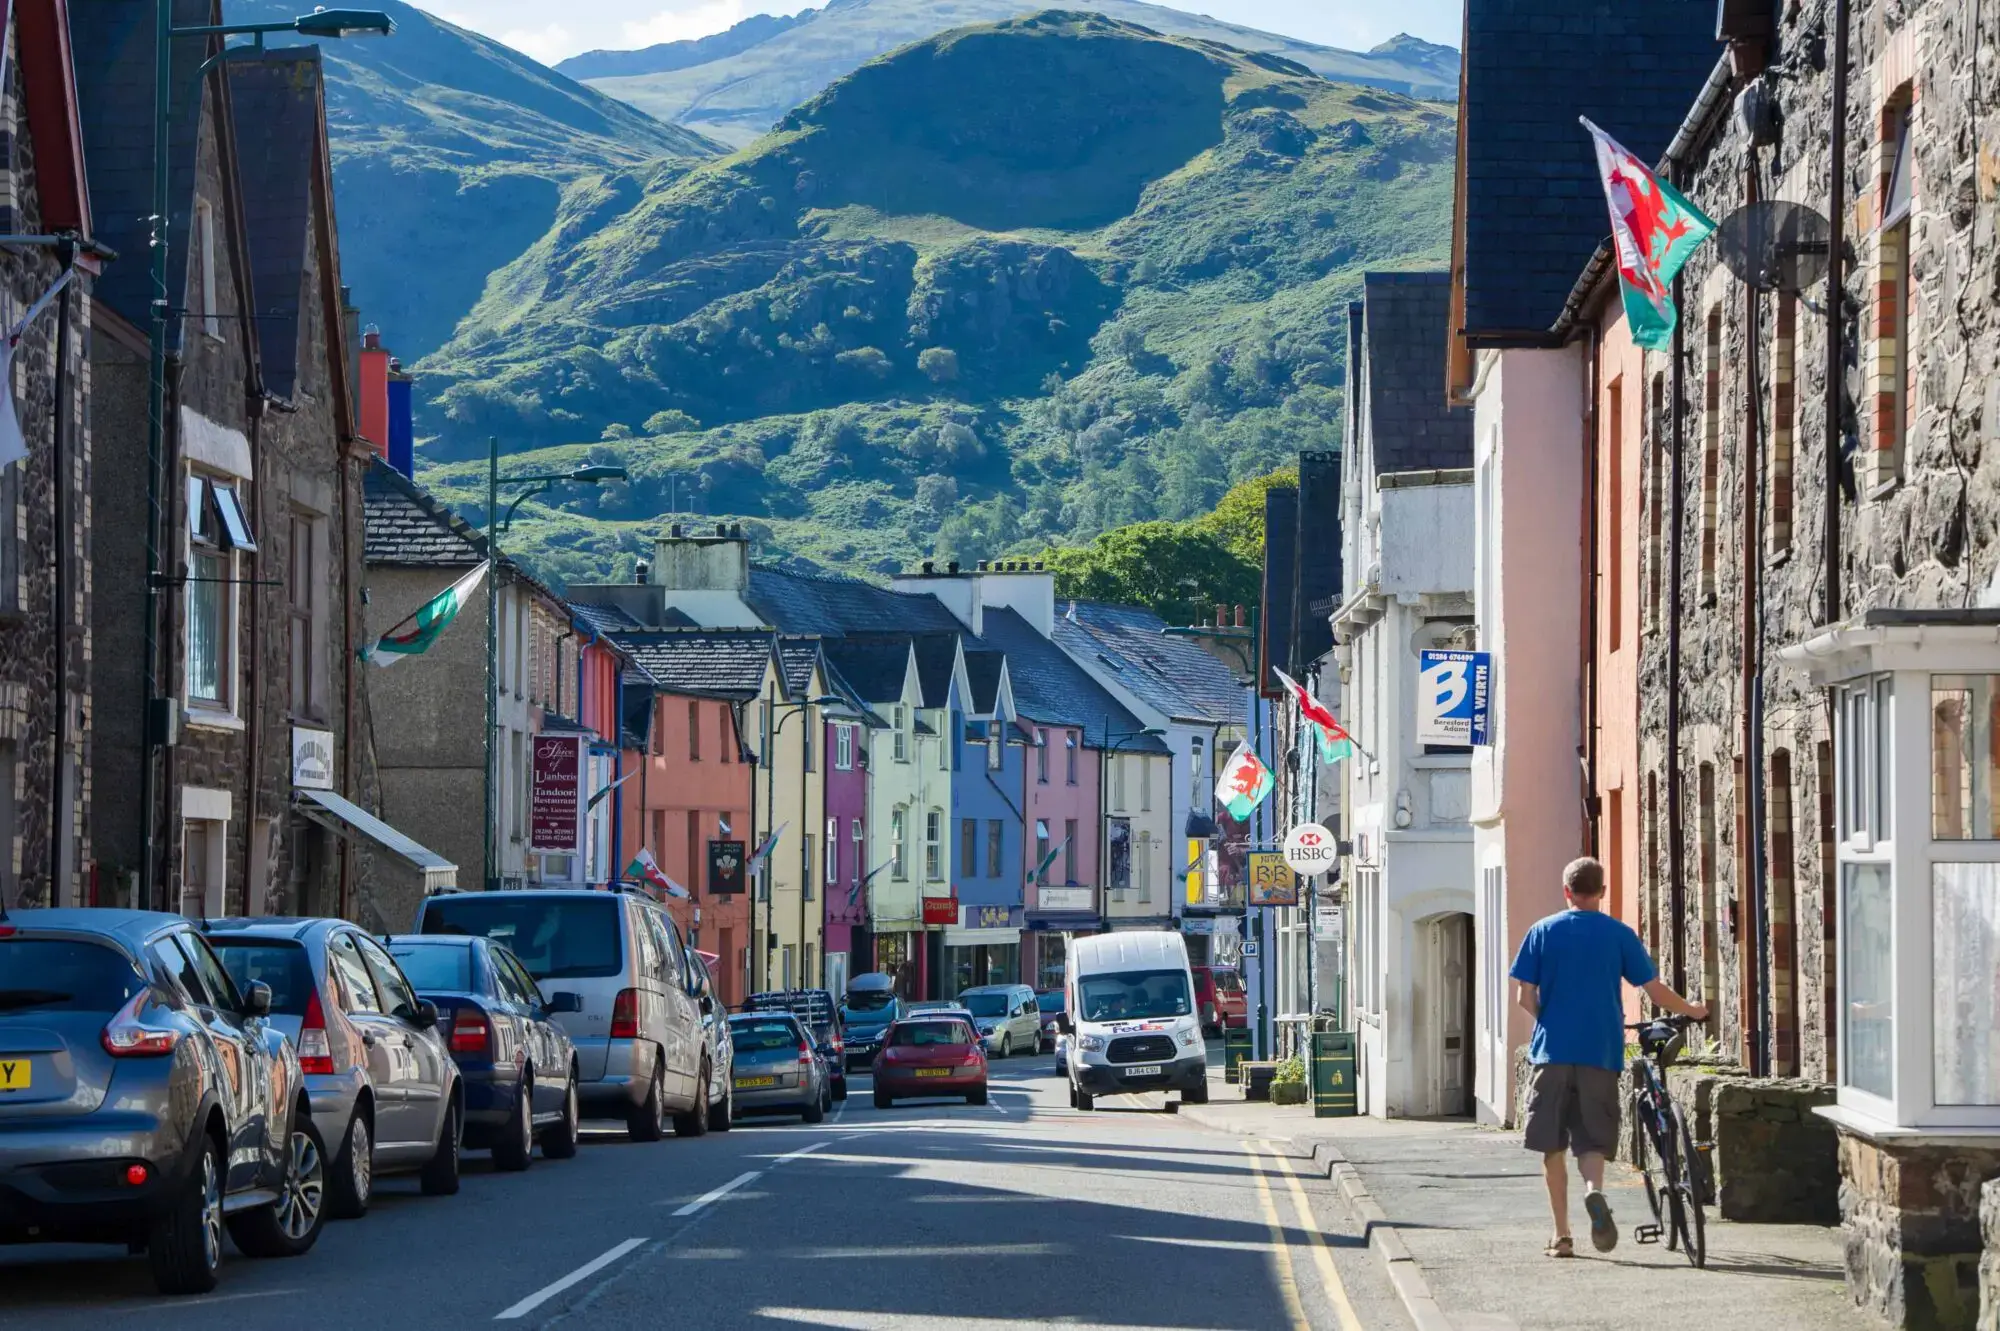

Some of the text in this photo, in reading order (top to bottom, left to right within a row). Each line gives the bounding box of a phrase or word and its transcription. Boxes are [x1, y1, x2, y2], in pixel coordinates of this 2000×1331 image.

[1474, 665, 1487, 732] AR WERTH
[537, 740, 576, 759] Spice
[536, 770, 577, 783] Llanberis
[534, 787, 576, 796] Tandoori
[1290, 847, 1332, 860] HSBC
[1113, 1024, 1165, 1033] FedEx
[2, 1062, 16, 1084] Y
